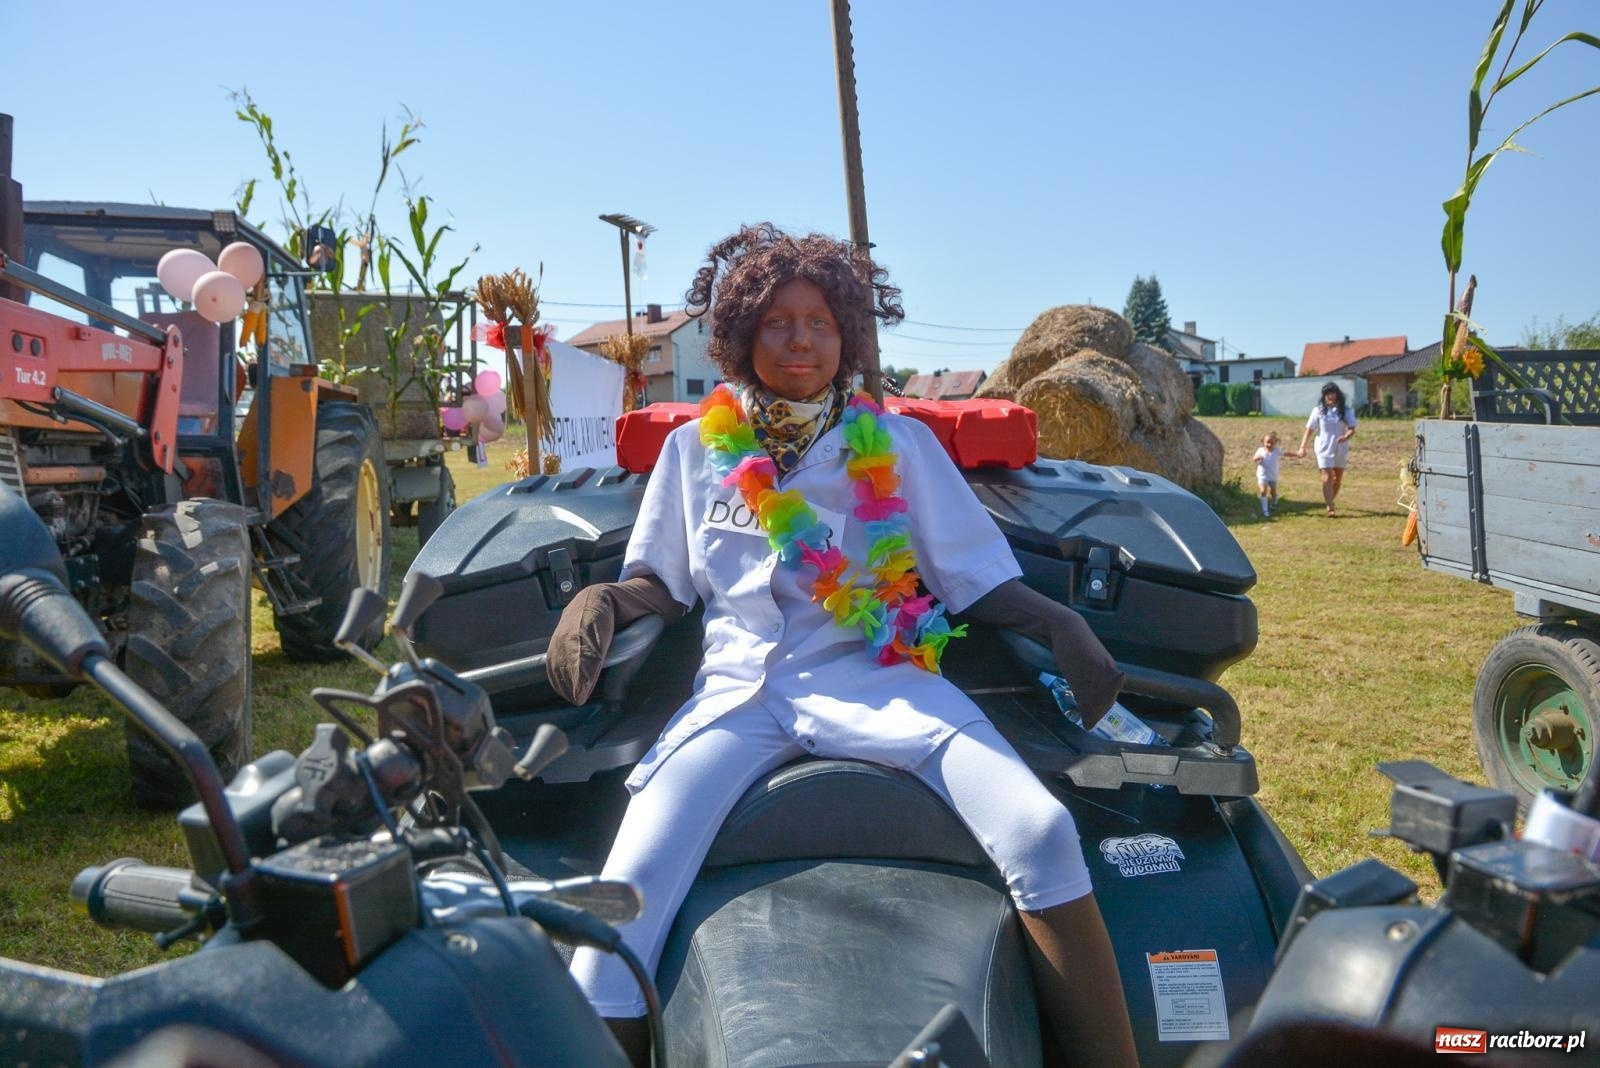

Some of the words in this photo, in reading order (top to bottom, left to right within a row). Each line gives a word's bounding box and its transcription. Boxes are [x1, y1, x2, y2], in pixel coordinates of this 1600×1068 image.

[15, 367, 31, 384] Tur
[32, 370, 46, 385] 4.2
[541, 416, 582, 460] PITAL
[1115, 840, 1158, 860] NIE
[1122, 866, 1135, 875] W
[1136, 861, 1179, 874] DOMU!
